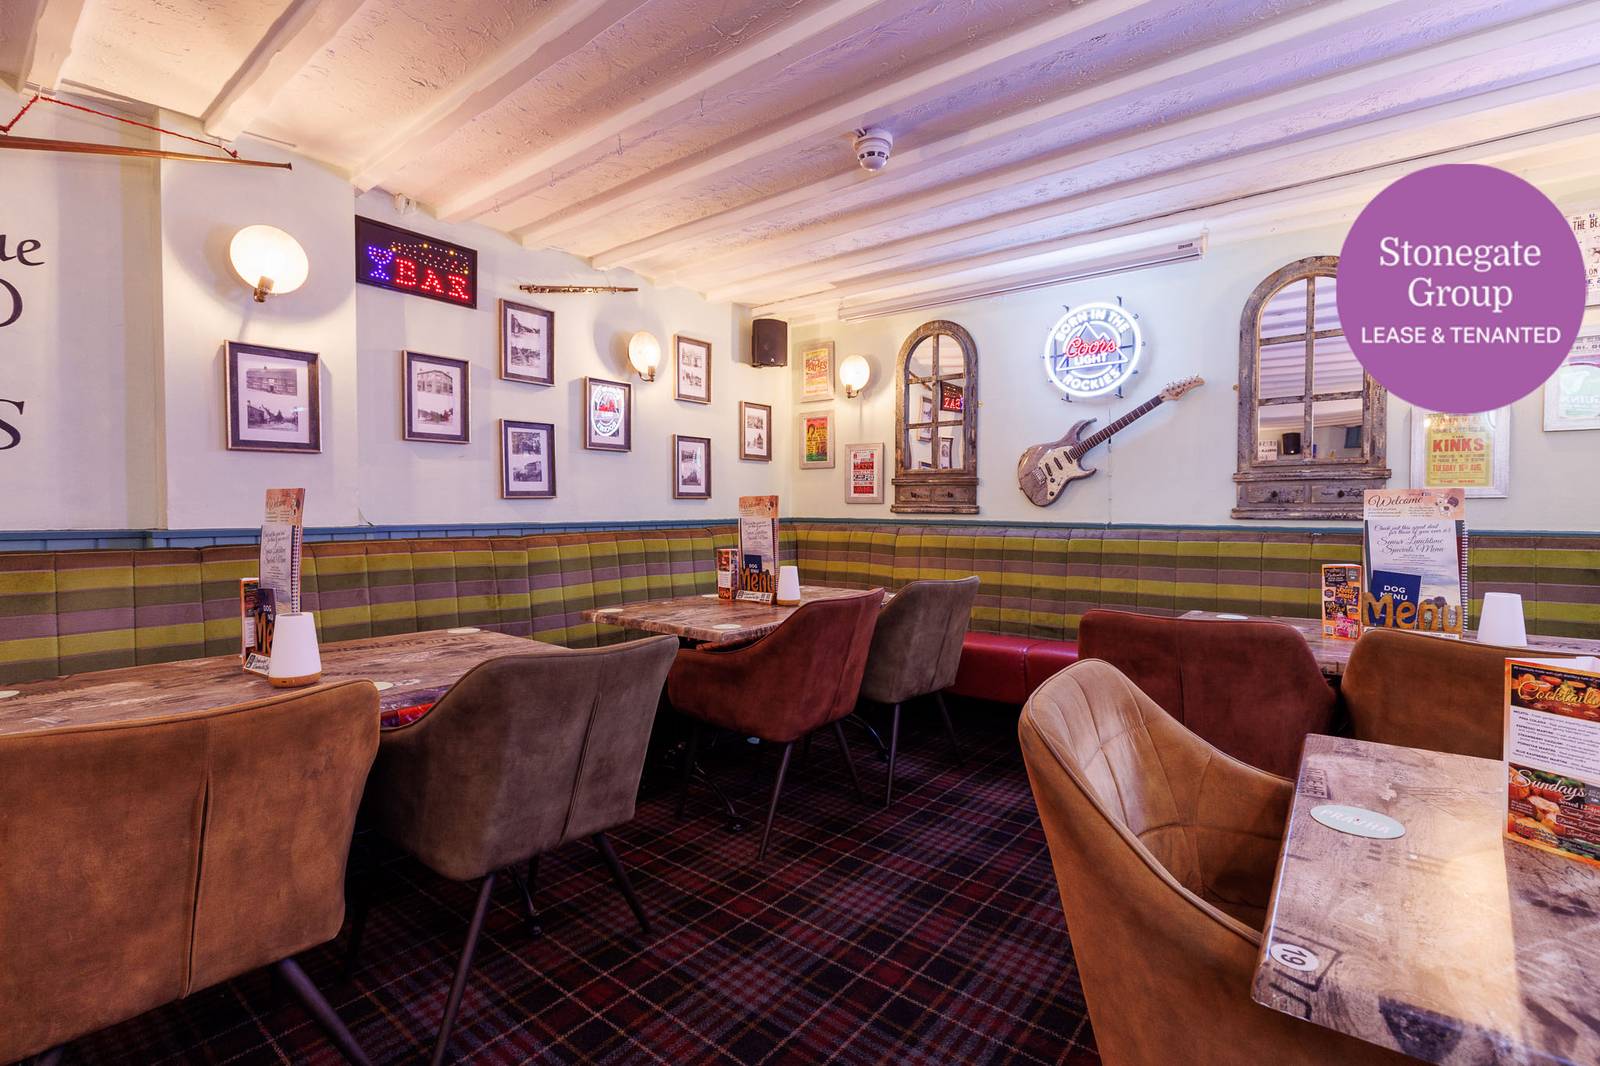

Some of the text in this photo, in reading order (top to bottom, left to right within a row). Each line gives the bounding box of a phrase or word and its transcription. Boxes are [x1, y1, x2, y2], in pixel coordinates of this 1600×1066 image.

[1590, 217, 1600, 228] BE
[395, 258, 470, 300] BAR
[1107, 311, 1130, 333] THE
[1066, 336, 1117, 358] Coors
[1063, 368, 1121, 391] ROCKIES
[1432, 438, 1485, 452] KINKS
[1367, 495, 1423, 507] Welcome
[740, 568, 773, 592] Menu
[1383, 585, 1406, 594] DOG
[1361, 592, 1463, 634] Menu
[1518, 769, 1587, 801] Sundays
[1281, 948, 1306, 966] 19
